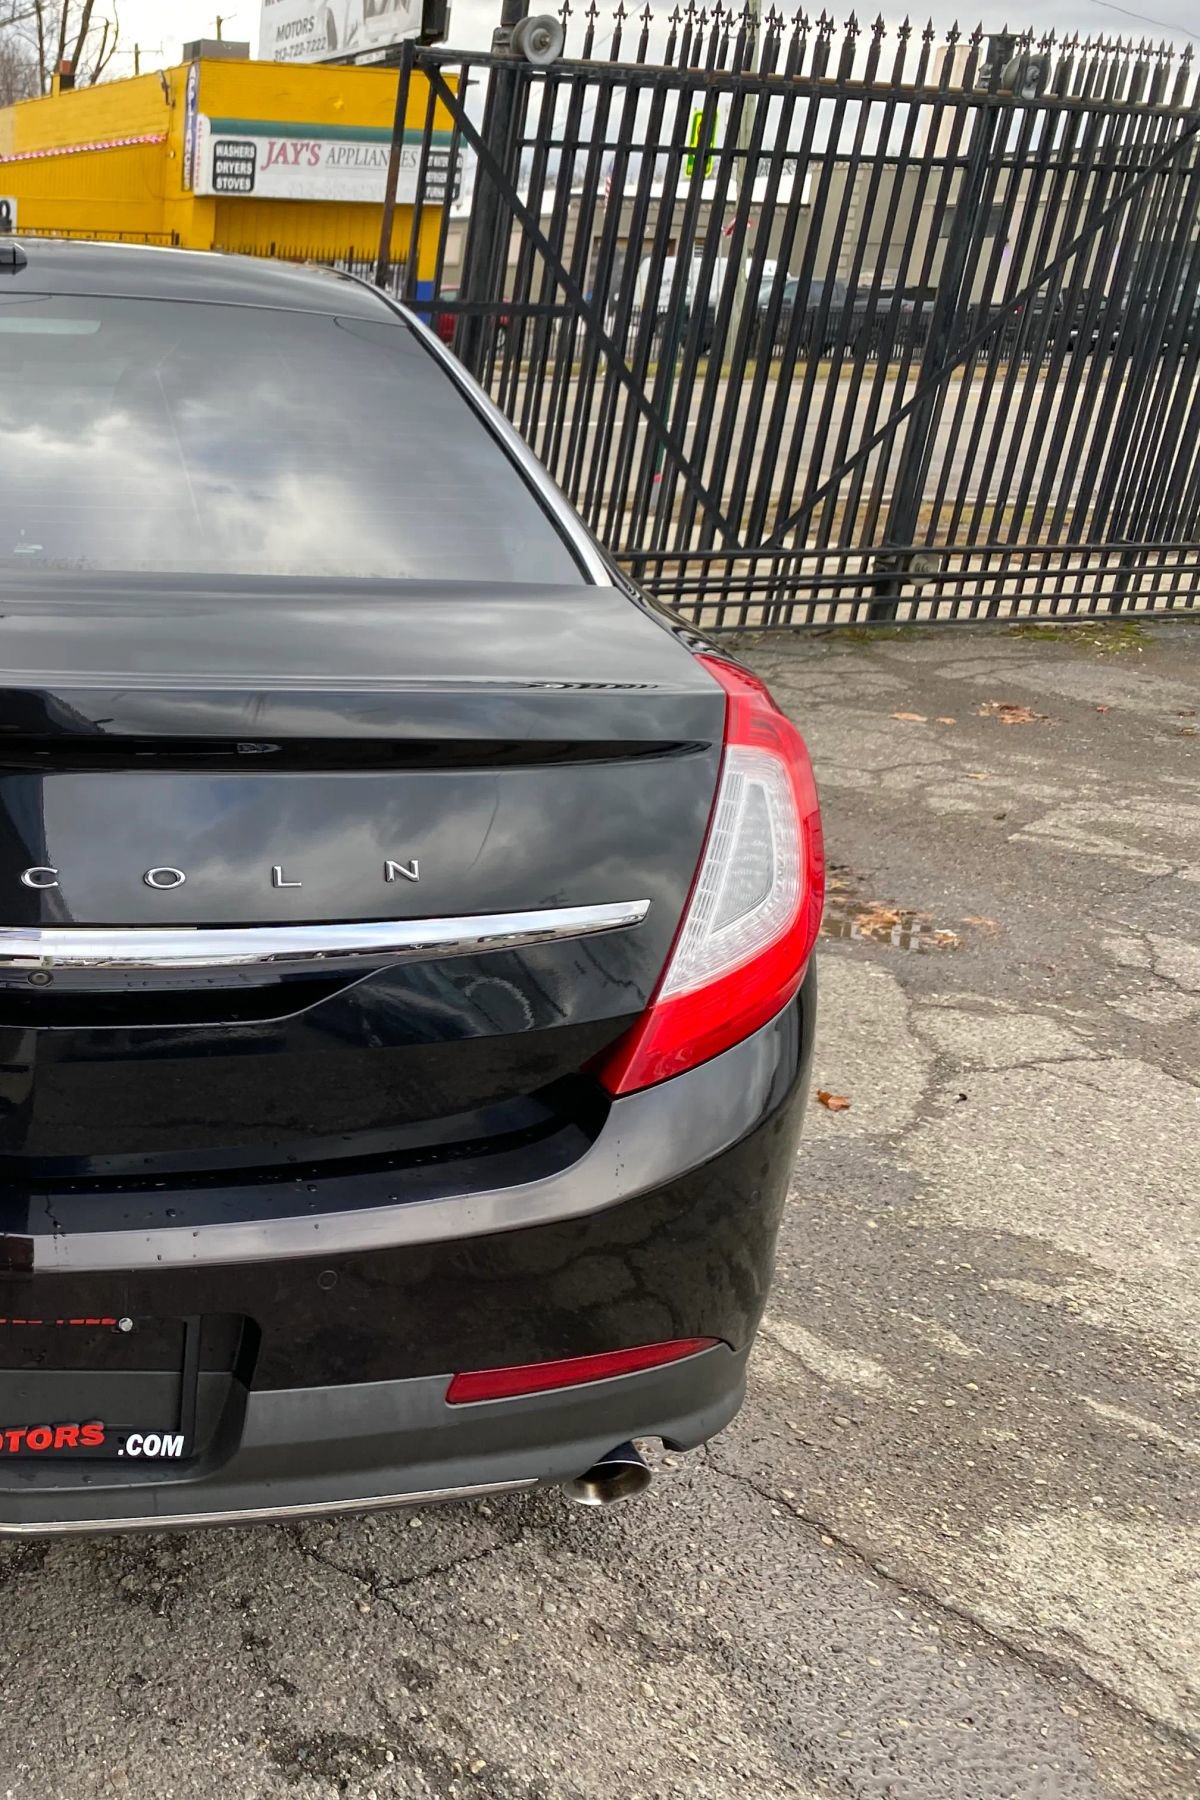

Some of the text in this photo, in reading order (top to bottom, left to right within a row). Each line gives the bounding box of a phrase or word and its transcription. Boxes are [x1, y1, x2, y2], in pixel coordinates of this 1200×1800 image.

[275, 15, 314, 42] MOTORS
[216, 144, 254, 158] WASHERS
[260, 141, 322, 171] JAY'S
[324, 145, 418, 169] APPLIANES
[216, 161, 253, 175] DRYERS
[216, 177, 252, 190] STOVES
[117, 1434, 185, 1457] .COM
